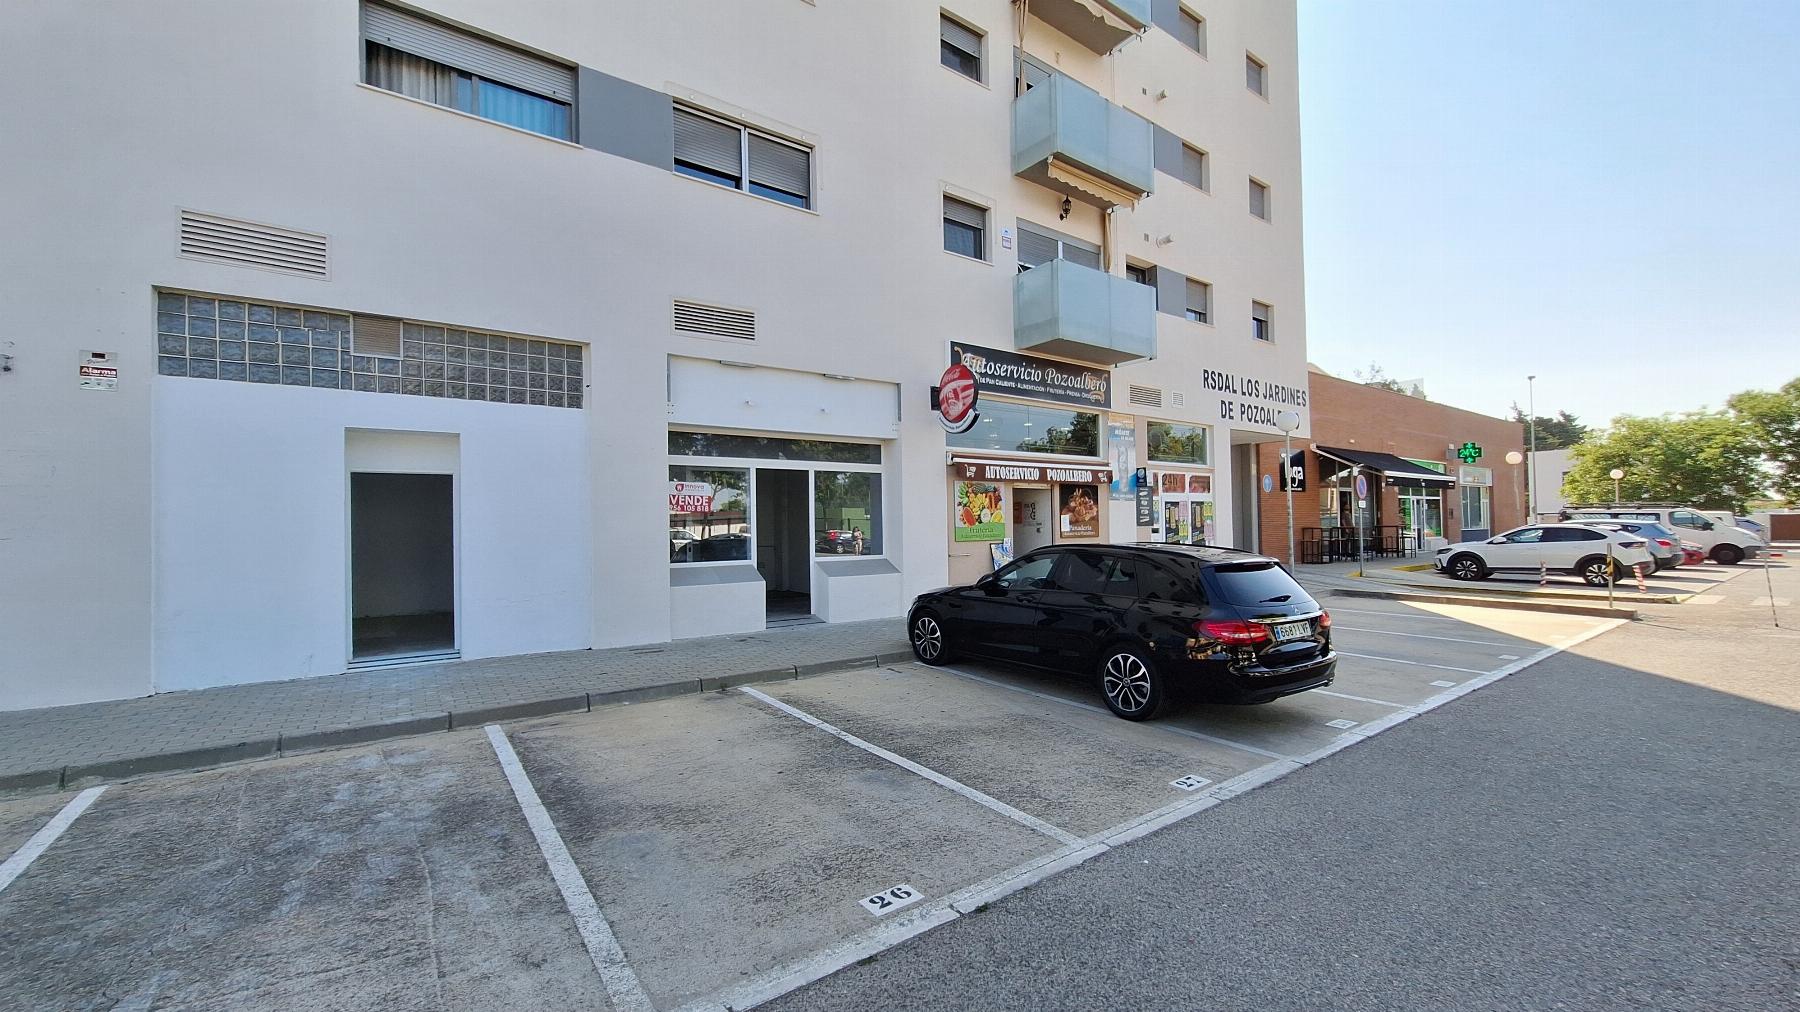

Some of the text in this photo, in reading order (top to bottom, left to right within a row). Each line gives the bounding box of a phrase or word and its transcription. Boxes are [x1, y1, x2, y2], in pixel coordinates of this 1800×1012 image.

[962, 353, 1107, 392] Autoservicio Pozoalbero
[1203, 368, 1307, 407] RSDAL LOS JARDINES
[1220, 399, 1300, 430] DE POZOAL
[985, 465, 1093, 483] AUTOSERVICIO POZOALBERO
[670, 495, 709, 506] VENDE
[1280, 625, 1297, 638] 6681
[868, 887, 913, 910] 26
